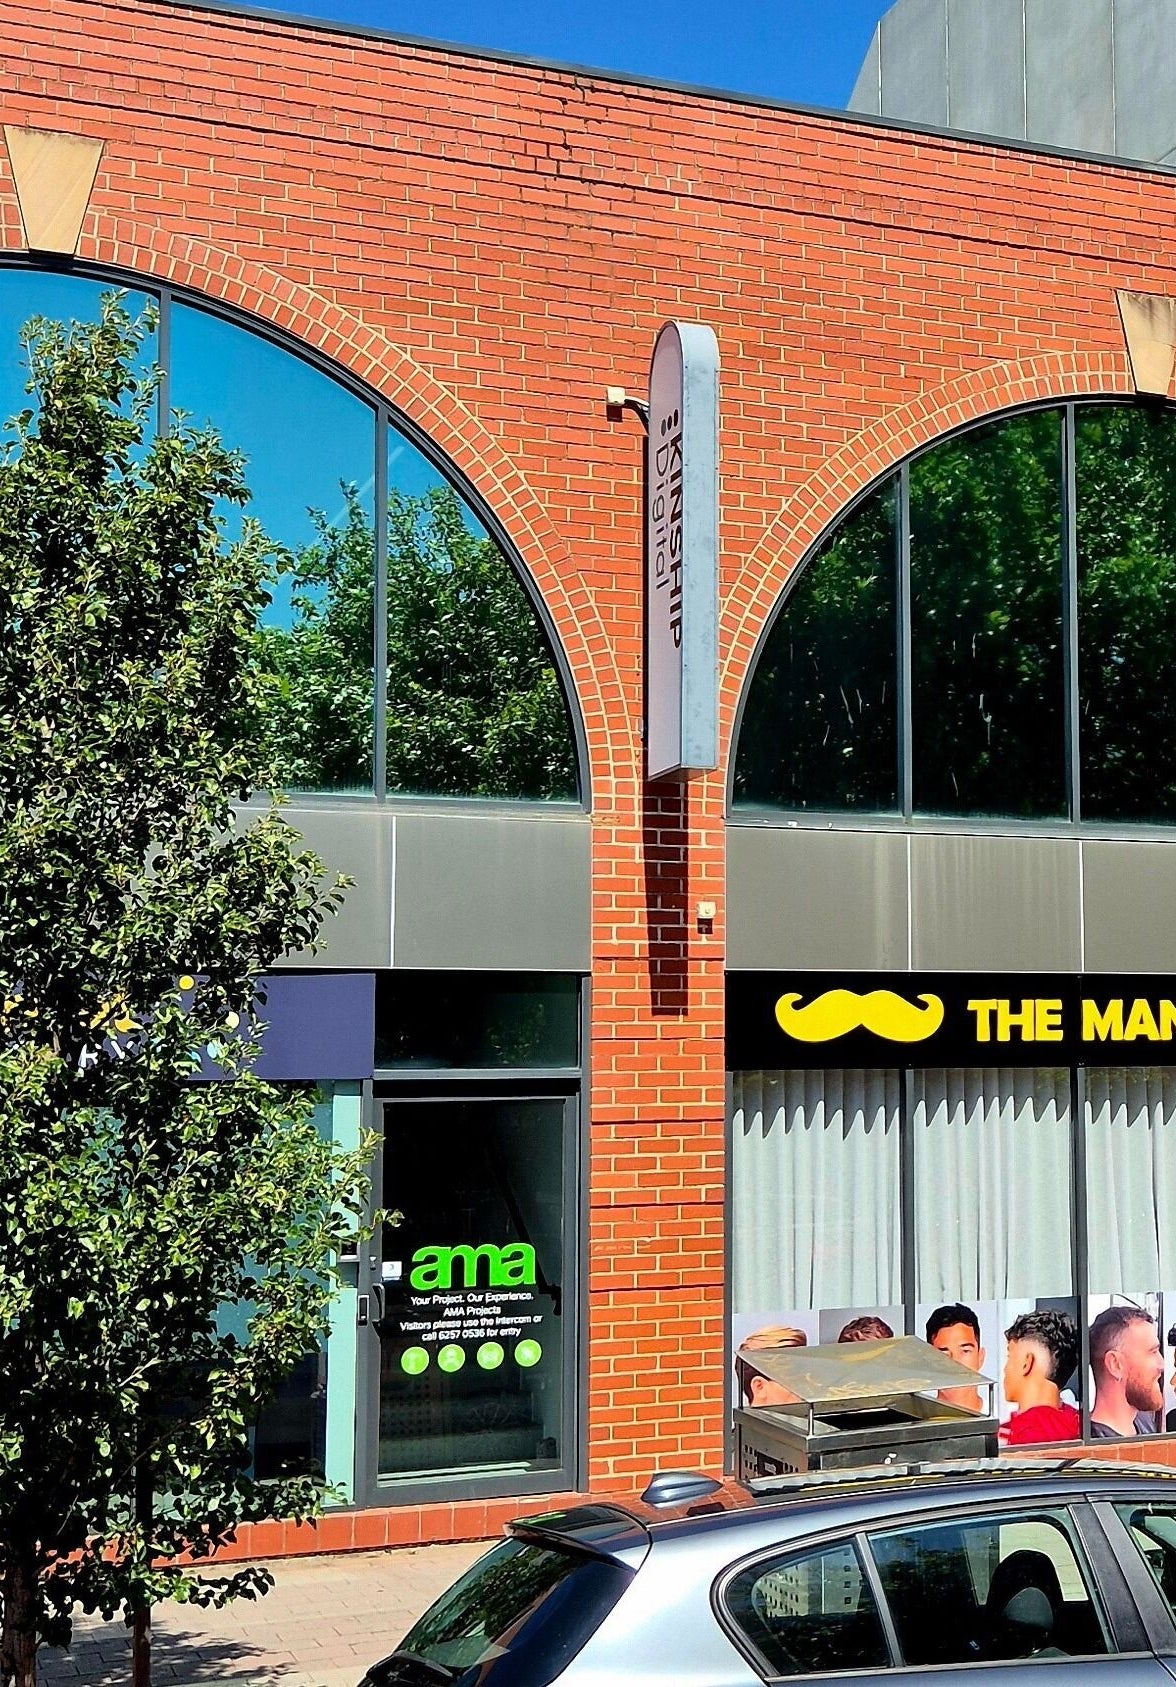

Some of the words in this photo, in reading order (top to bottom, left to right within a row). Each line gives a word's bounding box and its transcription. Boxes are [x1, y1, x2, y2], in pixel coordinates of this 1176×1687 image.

[652, 442, 670, 590] Digital
[669, 431, 683, 649] KINSHIP
[967, 998, 1063, 1042] THE
[410, 1243, 536, 1290] ama
[410, 1296, 431, 1306] Your
[432, 1294, 465, 1306] Project.
[466, 1293, 484, 1302] Our
[485, 1292, 534, 1304] Experience.
[443, 1307, 465, 1317] AMA
[467, 1306, 501, 1317] Projects
[400, 1321, 432, 1332] Visitors
[432, 1320, 461, 1331] please
[463, 1319, 479, 1328] use
[479, 1317, 494, 1326] the
[495, 1315, 531, 1325] intercom
[533, 1315, 543, 1323] or
[421, 1331, 437, 1342] call
[486, 1328, 498, 1337] for
[499, 1327, 522, 1338] entry
